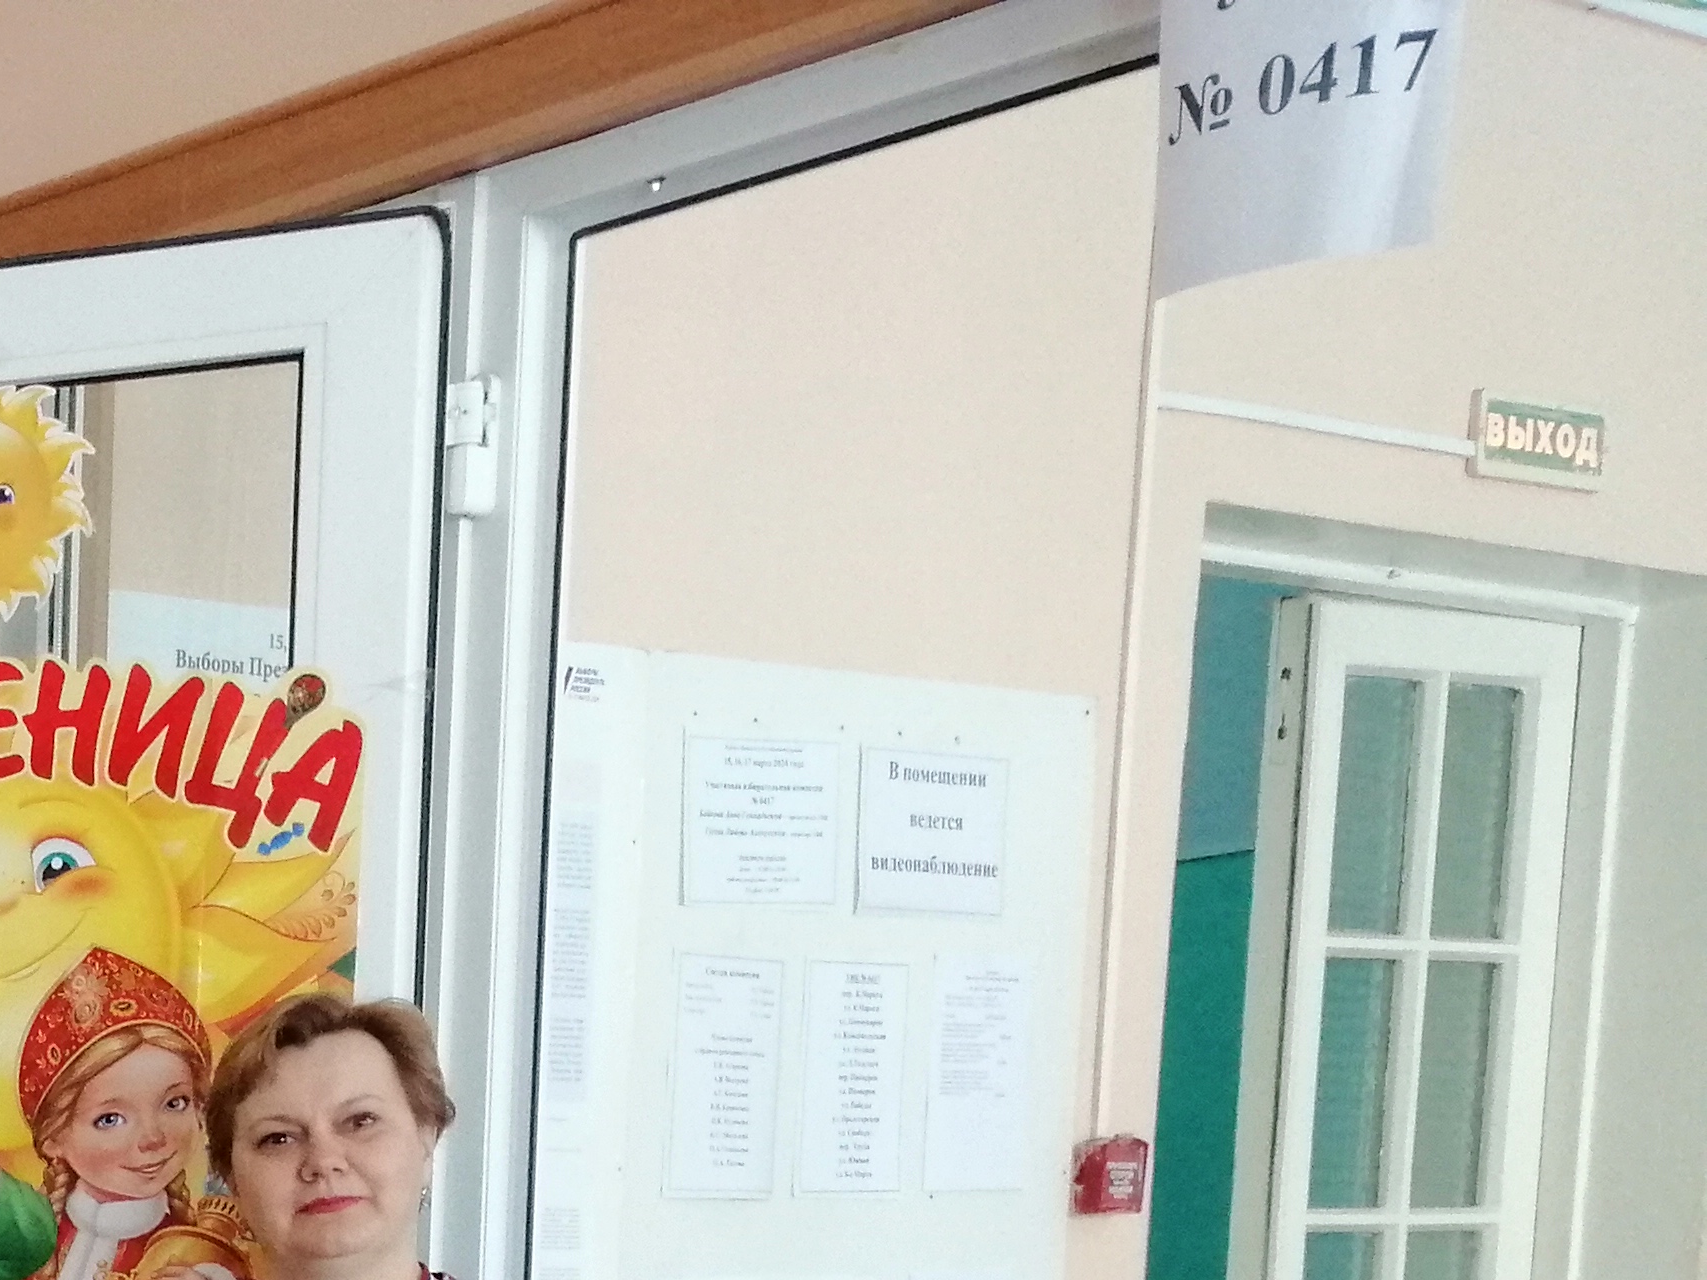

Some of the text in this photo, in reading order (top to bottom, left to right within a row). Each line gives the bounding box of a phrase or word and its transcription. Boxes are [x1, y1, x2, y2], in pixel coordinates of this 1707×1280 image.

[1169, 28, 1438, 145] № 0417
[1486, 412, 1599, 468] ВЫХОД
[176, 649, 244, 675] Выборы
[890, 761, 986, 788] В помещении
[910, 814, 962, 831] ведется
[872, 856, 998, 878] видеонаблюдение
